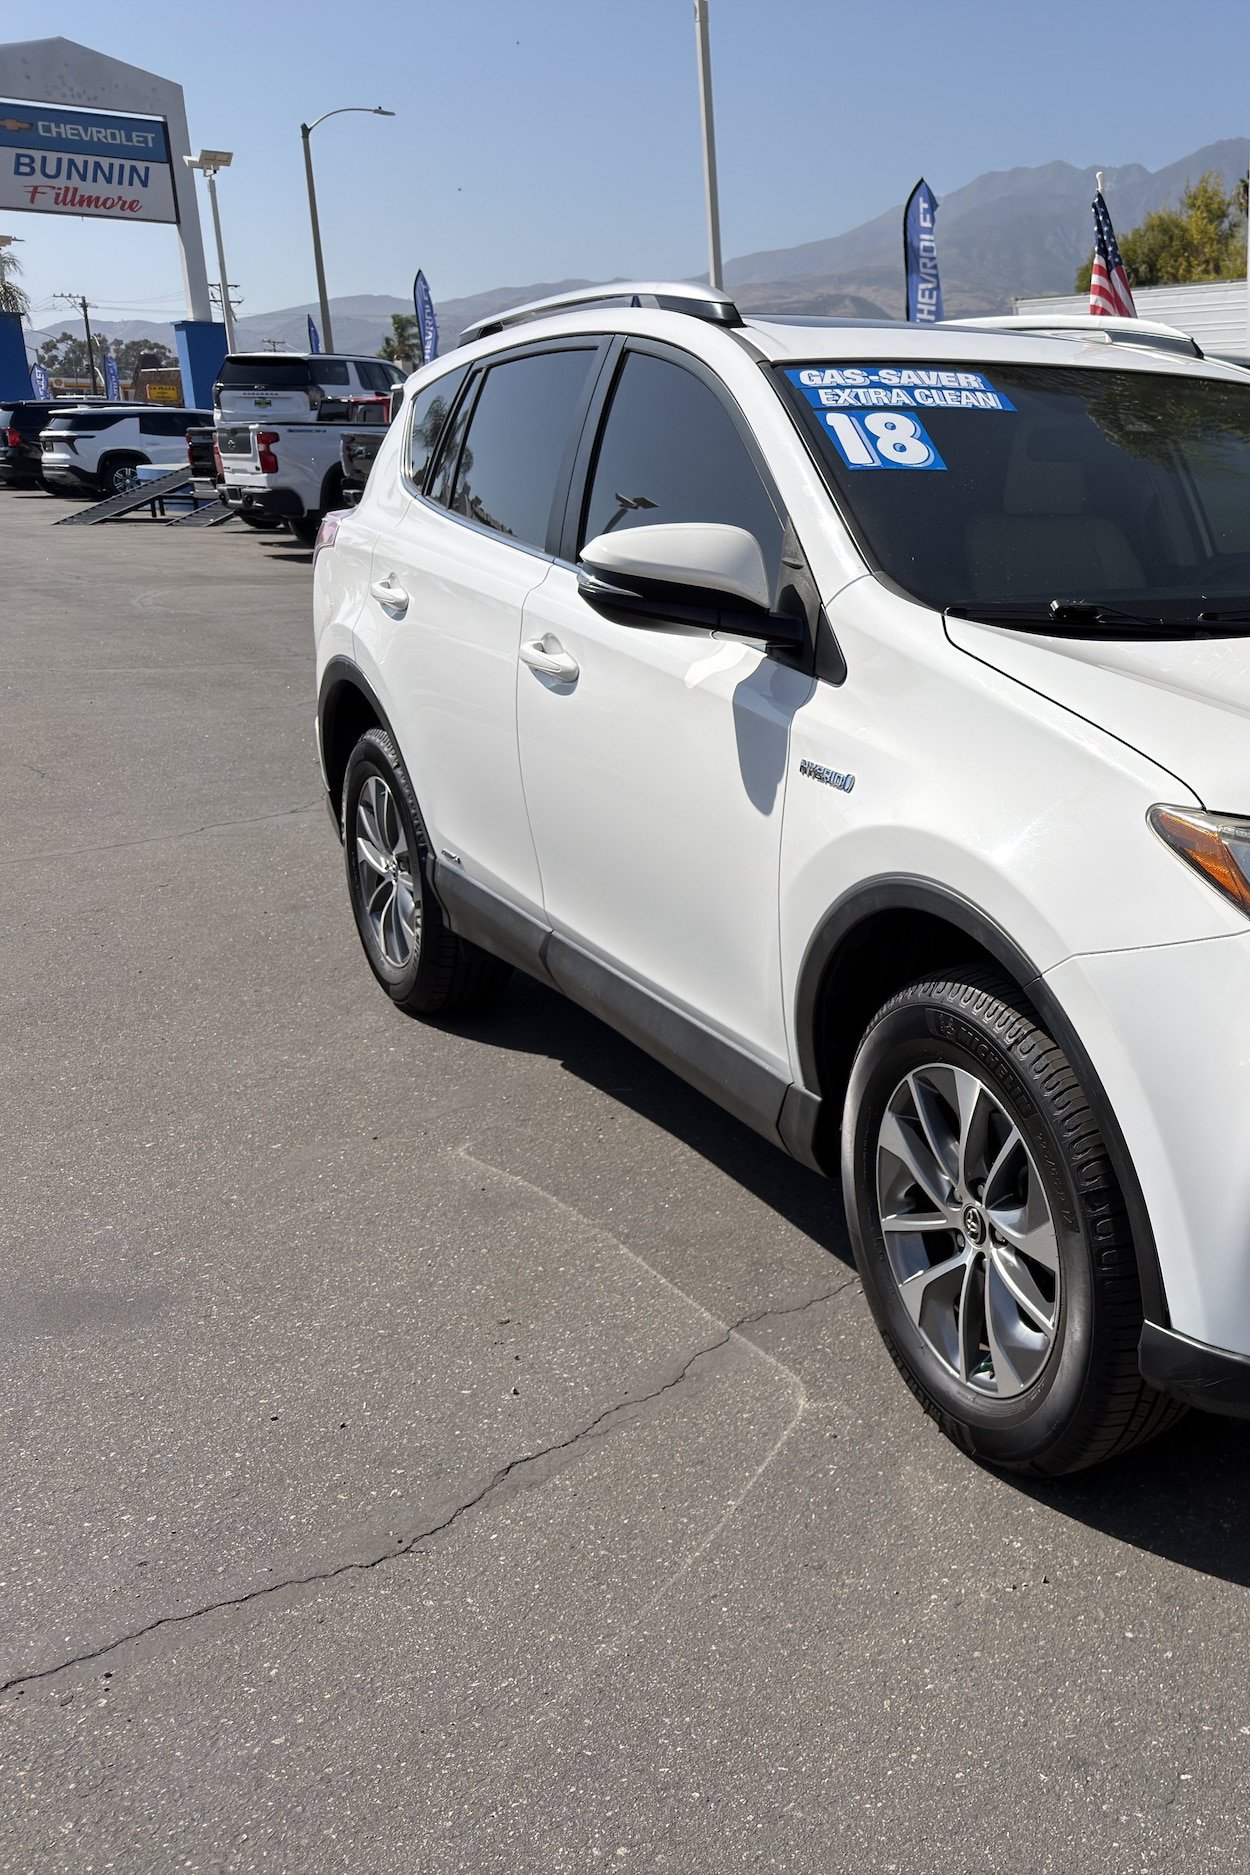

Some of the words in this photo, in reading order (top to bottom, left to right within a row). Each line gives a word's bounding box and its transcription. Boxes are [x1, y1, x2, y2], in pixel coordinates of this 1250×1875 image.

[37, 121, 156, 148] CHEVROLET
[13, 152, 150, 189] BUNNIN
[23, 184, 143, 213] Fillmore
[916, 197, 939, 323] HEVROLET
[799, 368, 986, 390] GAS-SAVER
[818, 388, 917, 407] EXTRA
[913, 390, 1003, 410] CLEAN
[825, 412, 935, 467] 18
[957, 1025, 1035, 1119] MICHELIN
